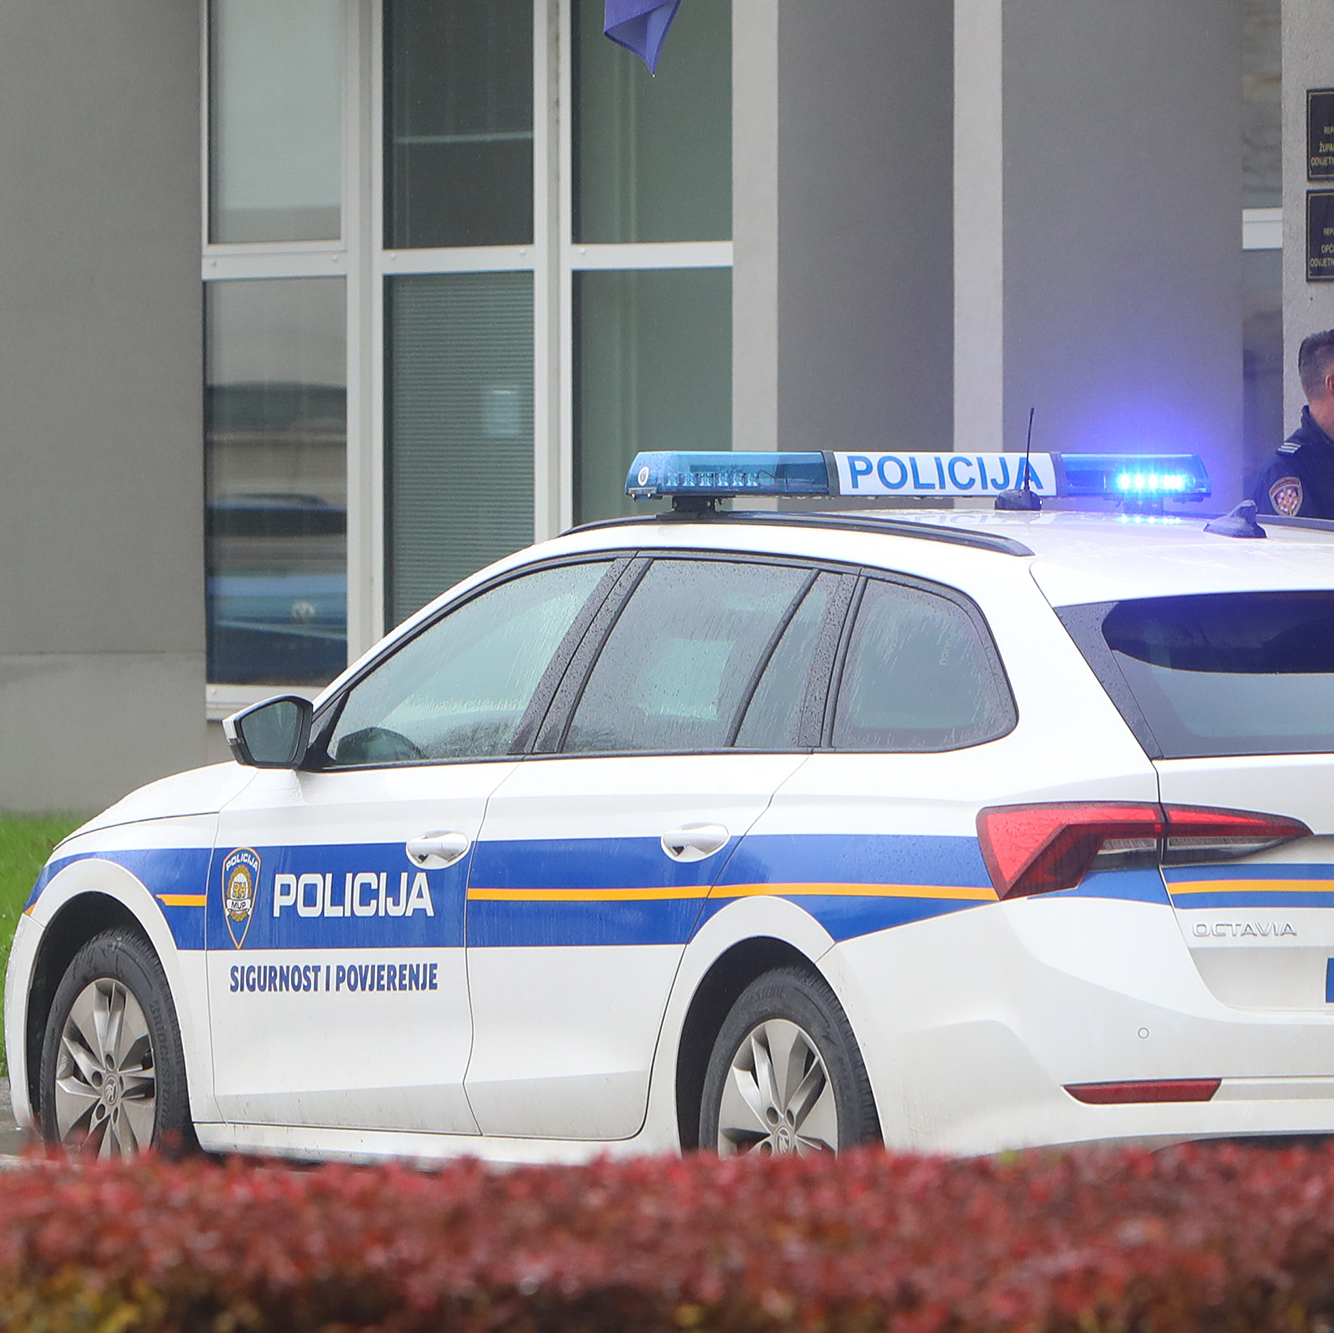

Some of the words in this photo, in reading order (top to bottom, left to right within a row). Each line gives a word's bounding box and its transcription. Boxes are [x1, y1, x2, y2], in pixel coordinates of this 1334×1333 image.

[847, 455, 1044, 490] POLICIJA
[226, 853, 258, 871] POLICIJA
[231, 901, 247, 910] MUP
[273, 872, 435, 917] POLICIJA
[1192, 922, 1298, 937] OCTAVIA
[229, 965, 321, 993] SIGURNOST
[325, 965, 331, 991] I
[335, 963, 438, 992] POVJERENJE
